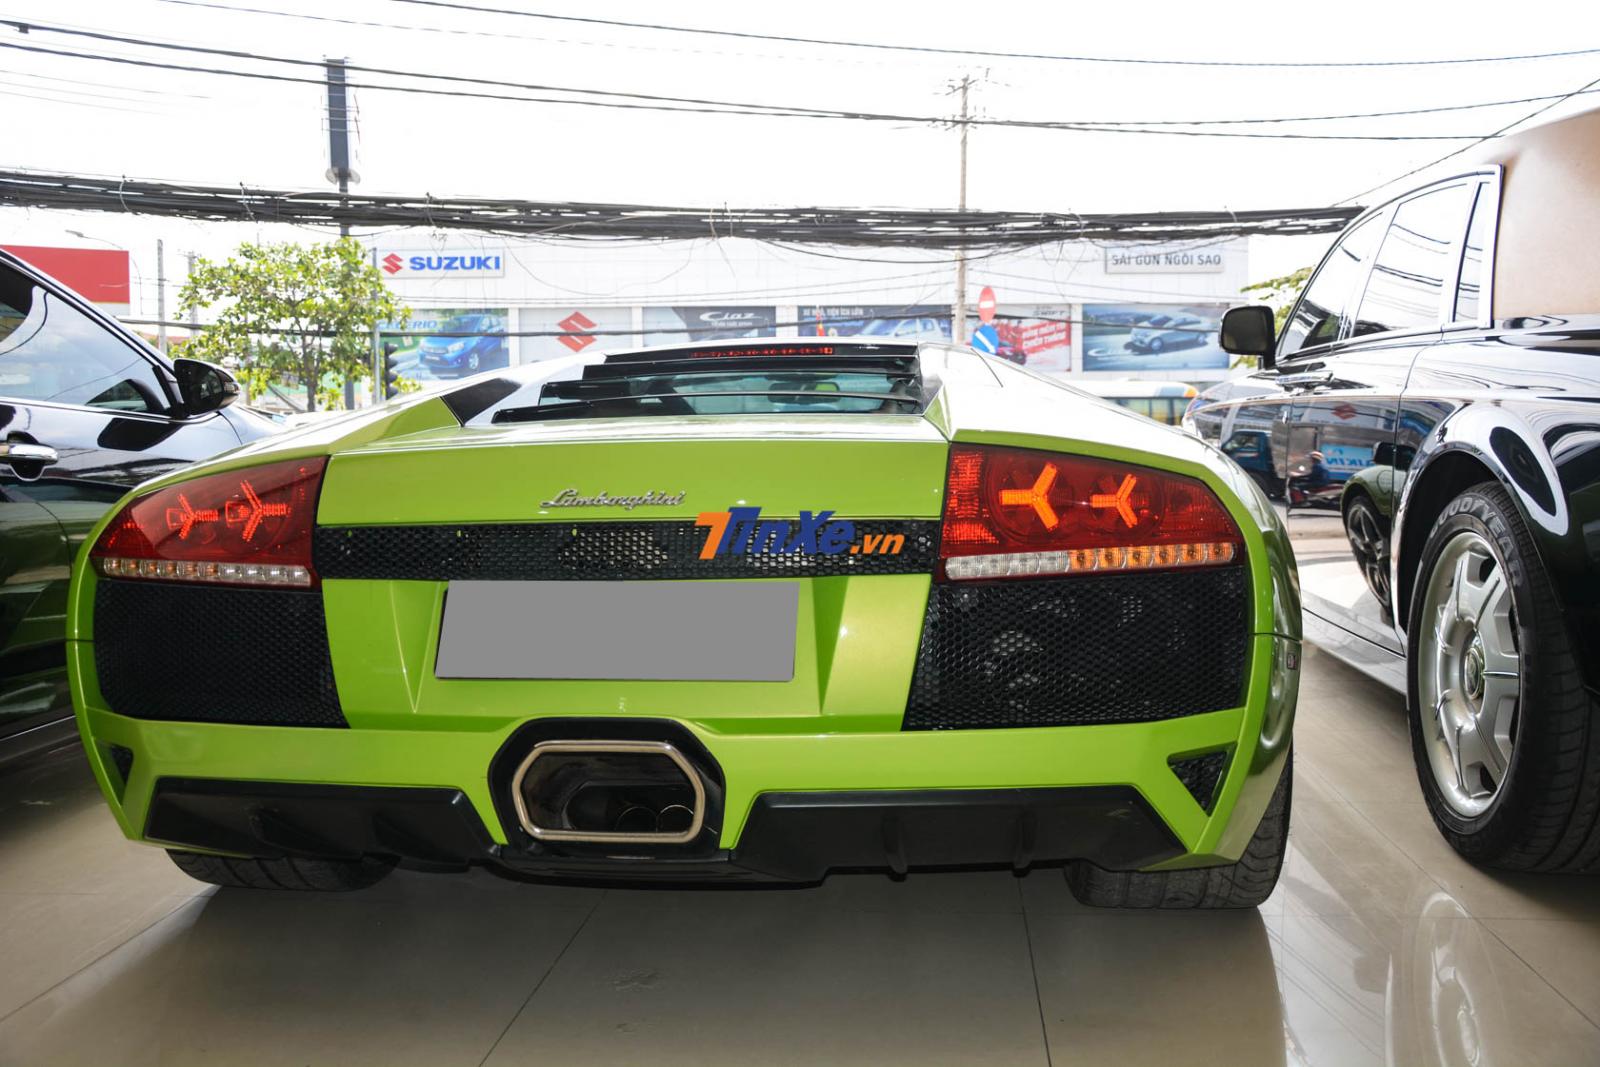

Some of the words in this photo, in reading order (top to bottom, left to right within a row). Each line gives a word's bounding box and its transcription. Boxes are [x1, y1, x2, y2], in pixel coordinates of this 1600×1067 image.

[409, 256, 501, 270] SUZUKI
[1197, 254, 1222, 266] SAO
[700, 311, 762, 321] Ciaz
[540, 489, 687, 510] Lamborghini
[1429, 497, 1524, 588] GOODYEAR
